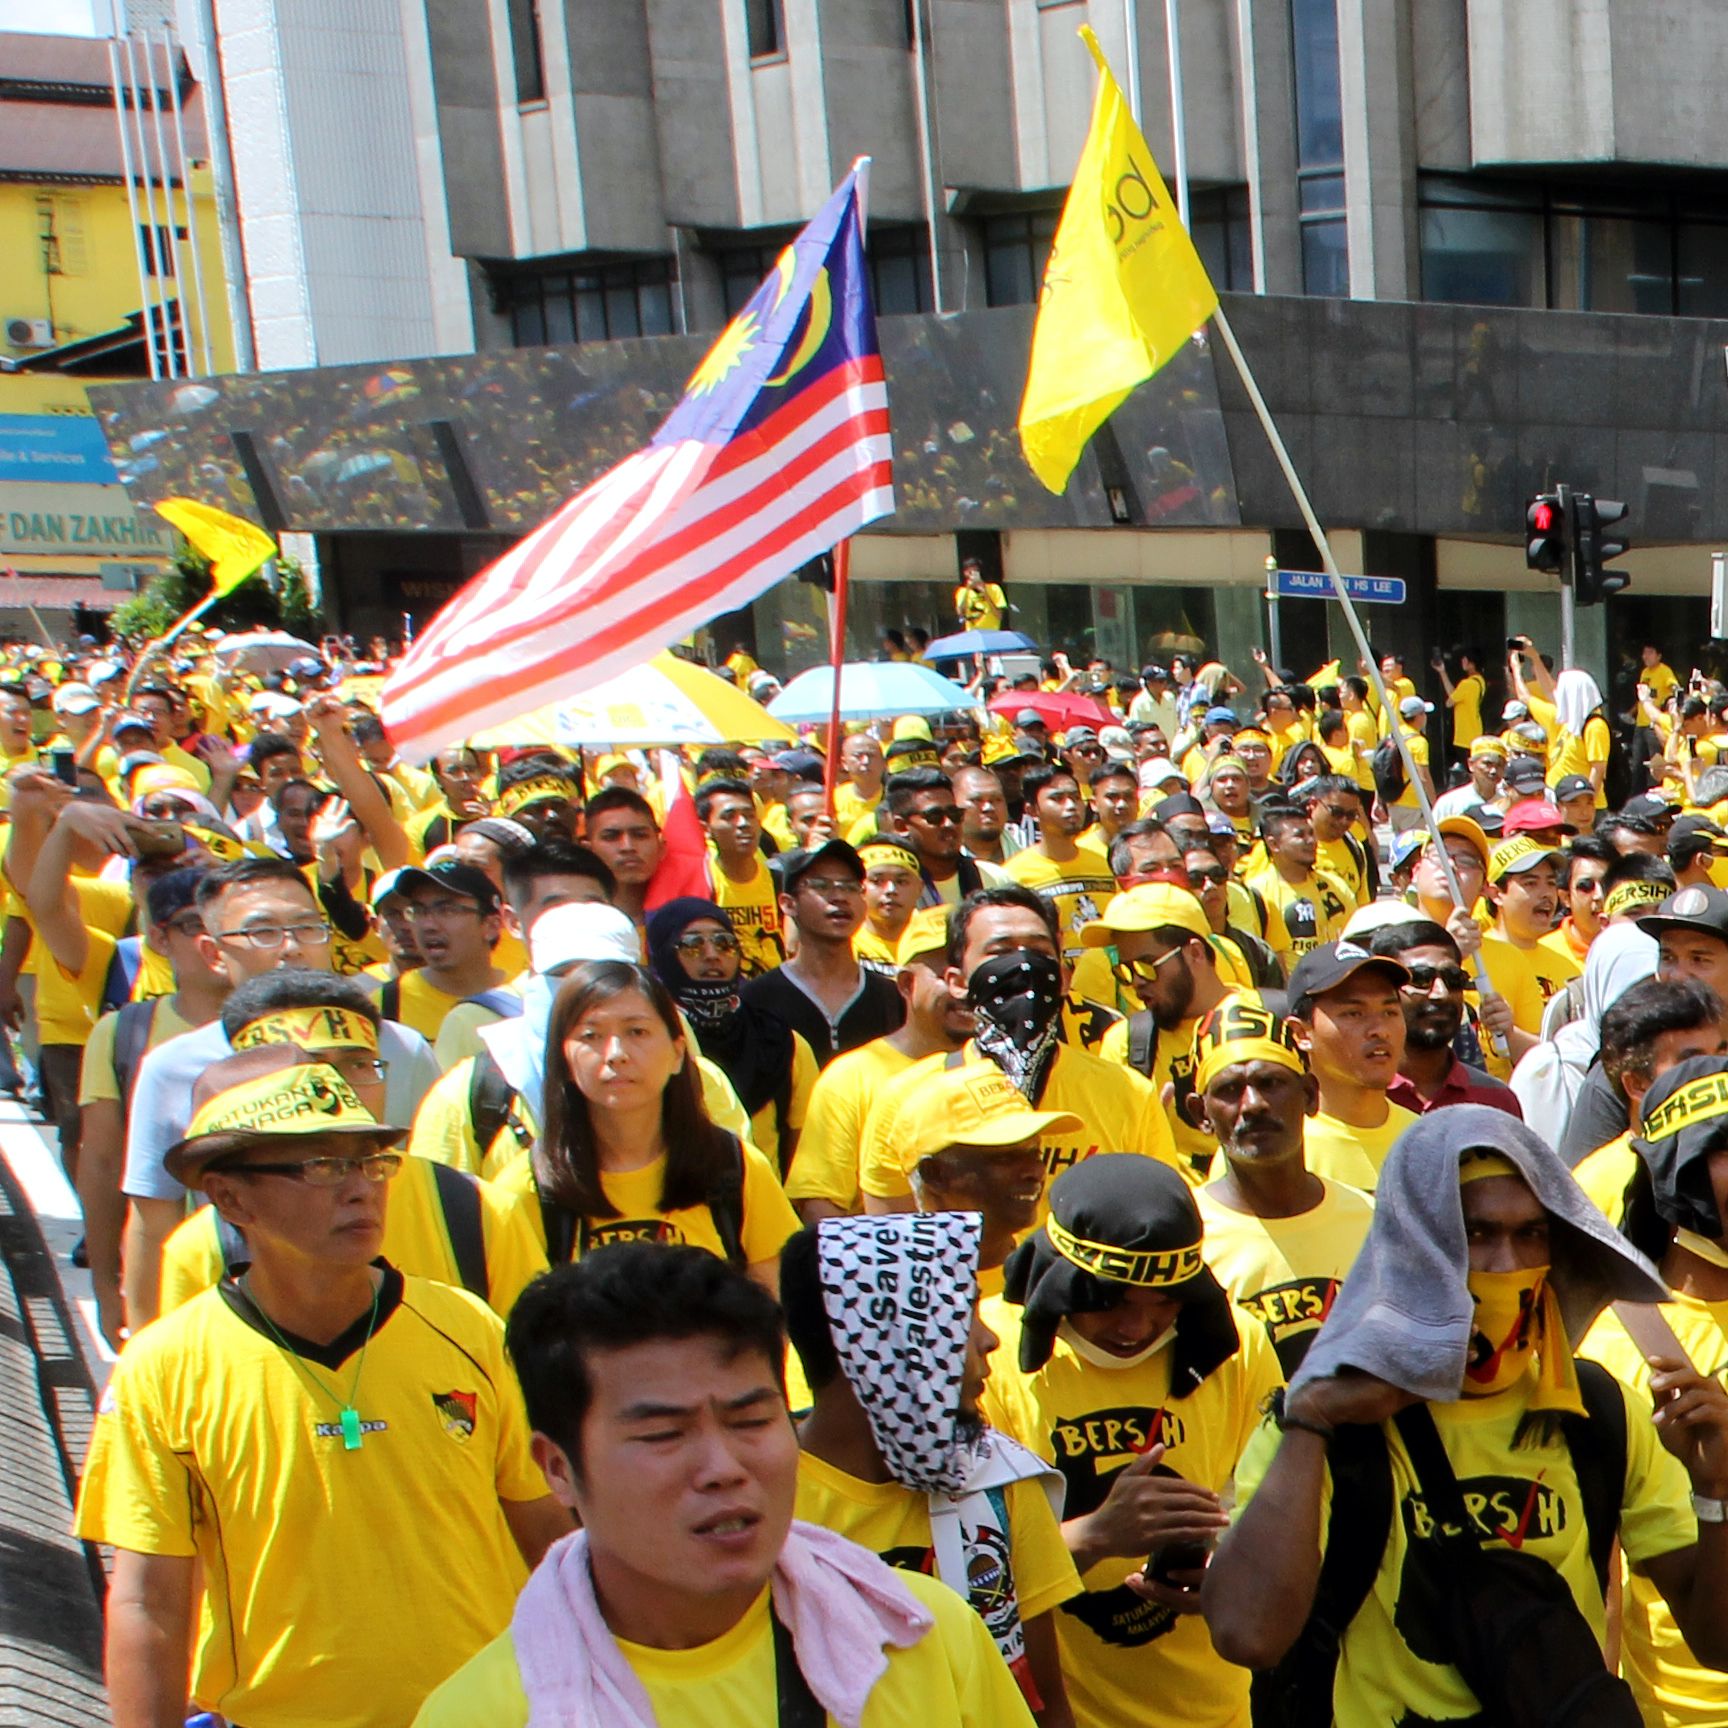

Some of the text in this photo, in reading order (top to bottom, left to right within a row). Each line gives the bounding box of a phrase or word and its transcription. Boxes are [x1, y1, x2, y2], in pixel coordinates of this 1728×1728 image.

[9, 511, 65, 543] DAN
[1289, 576, 1323, 588] JALAN
[1373, 582, 1393, 594] LEE
[868, 1226, 902, 1326] save
[903, 1210, 937, 1379] palestine
[317, 1420, 387, 1437] Kapa
